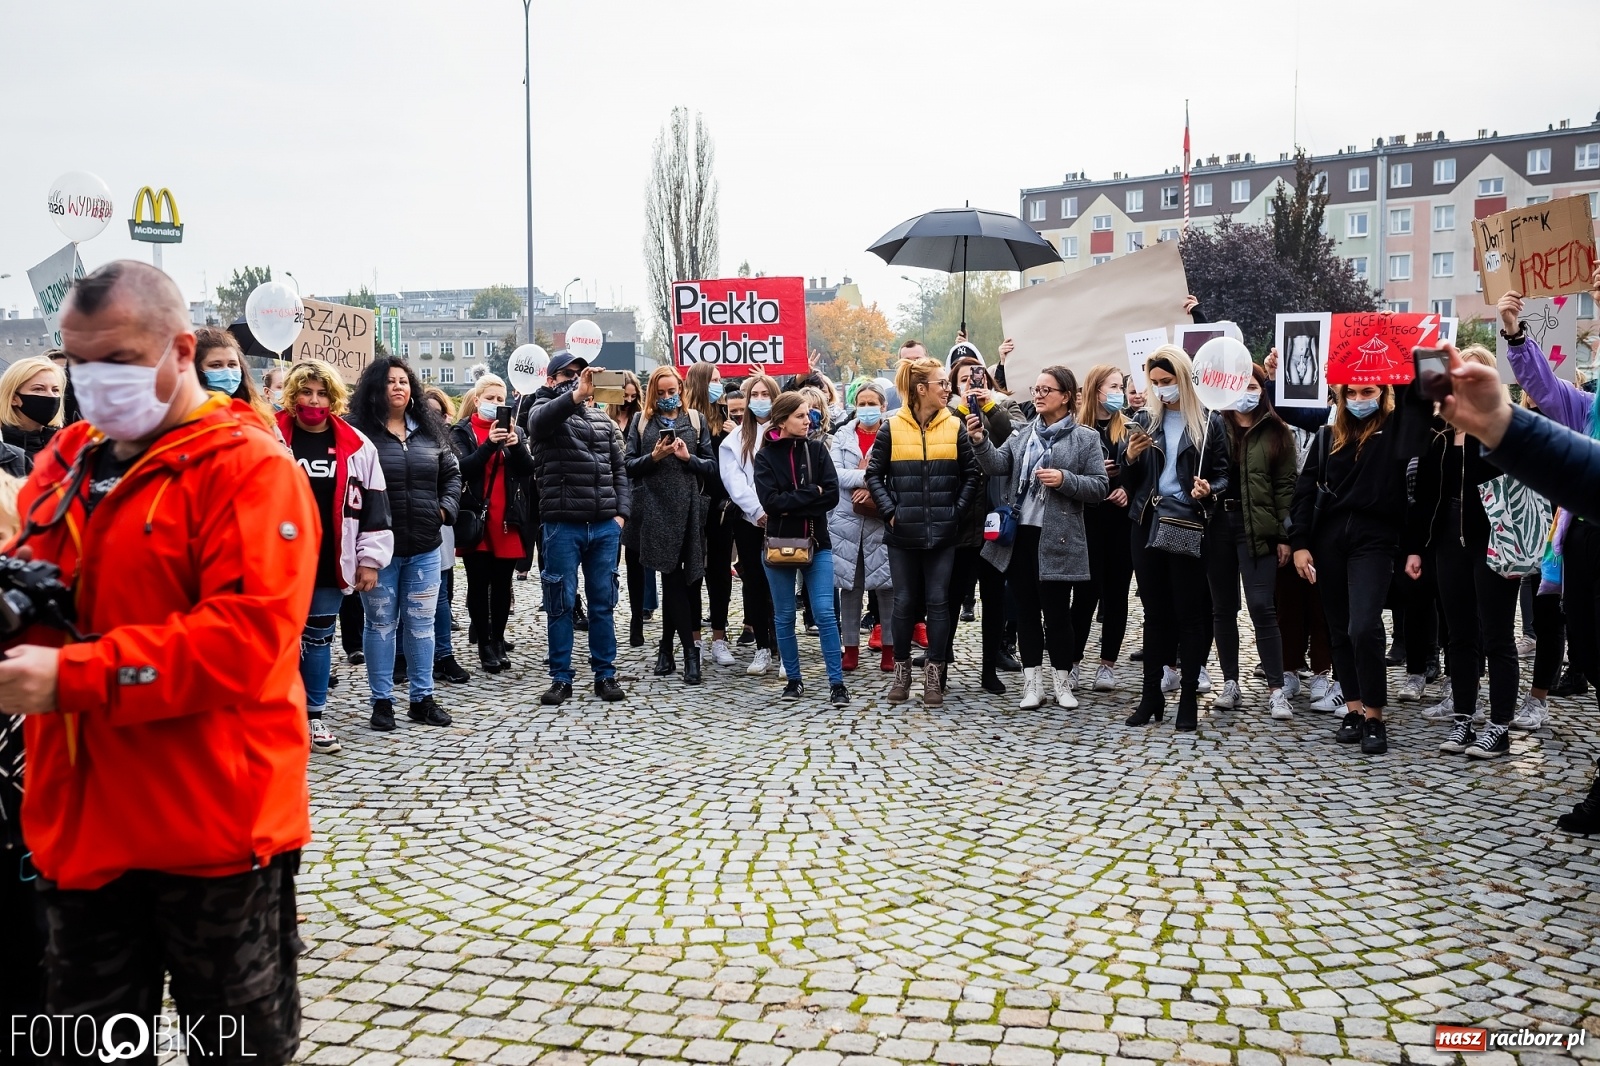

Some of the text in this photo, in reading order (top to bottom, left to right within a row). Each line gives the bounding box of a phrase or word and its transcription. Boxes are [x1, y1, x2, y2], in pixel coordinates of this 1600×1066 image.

[134, 226, 181, 237] McDonald's
[675, 285, 779, 325] Piekło
[302, 306, 367, 341] RZĄD
[1344, 314, 1397, 328] CHCEMY
[1389, 325, 1419, 335] TEGO
[323, 335, 341, 348] DO
[678, 332, 783, 365] Kobiet
[300, 342, 366, 371] ABORCJI
[514, 363, 535, 375] 2020
